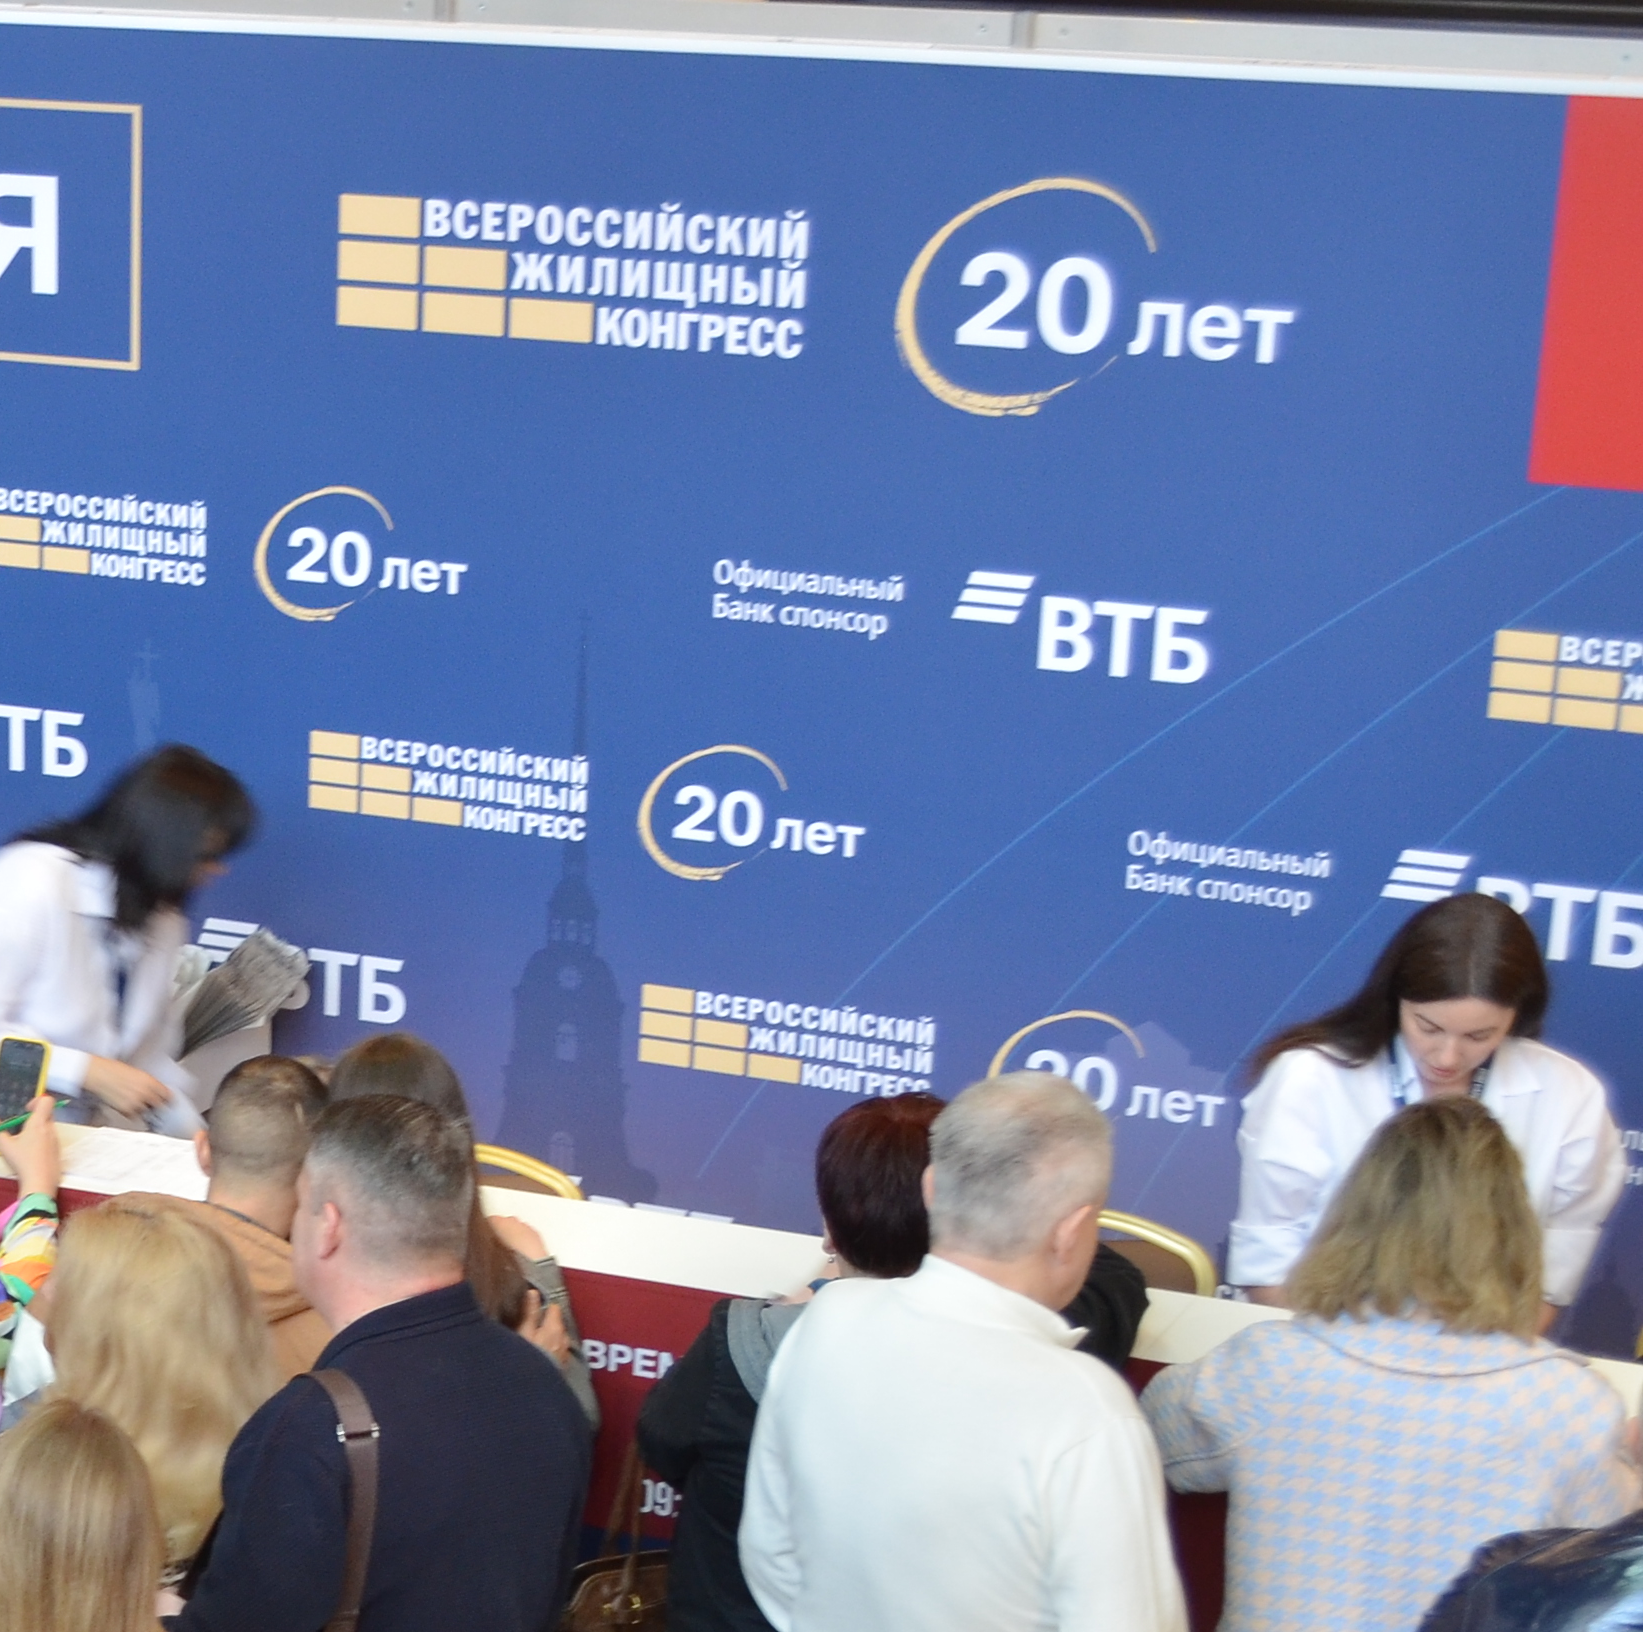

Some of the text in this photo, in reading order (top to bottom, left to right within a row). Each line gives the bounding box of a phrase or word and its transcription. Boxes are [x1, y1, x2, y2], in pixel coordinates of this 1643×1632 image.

[424, 196, 811, 261] ВСЕРОССИЙСКИЙ
[510, 250, 809, 312] ЖИЛИЩНЫЙ
[595, 303, 804, 361] КОНГРЕСС
[955, 251, 1295, 365] 20 лет
[41, 518, 207, 559] ЖИЛИЩНЫЙ
[286, 526, 469, 596] 20 лет
[90, 551, 207, 588] КОНГРЕСС
[713, 558, 905, 602] Официальный
[712, 593, 889, 641] Банк спонсор
[1036, 595, 1210, 685] ВТБ
[360, 735, 589, 786] ВСЕРОССИЙСКИЙ
[412, 769, 588, 815] ЖИЛИЩНЫЙ
[463, 803, 587, 843] КОНГРЕСС
[671, 785, 866, 860] 20 лет
[1126, 828, 1331, 879] Официальный
[1125, 864, 1314, 917] Банк спонсор
[308, 948, 408, 1025] ТБ
[694, 990, 936, 1047] ВСЕРОССИЙСКИЙ
[748, 1026, 934, 1075] ЖИЛИЩНЫЙ
[1124, 1085, 1226, 1128] лет
